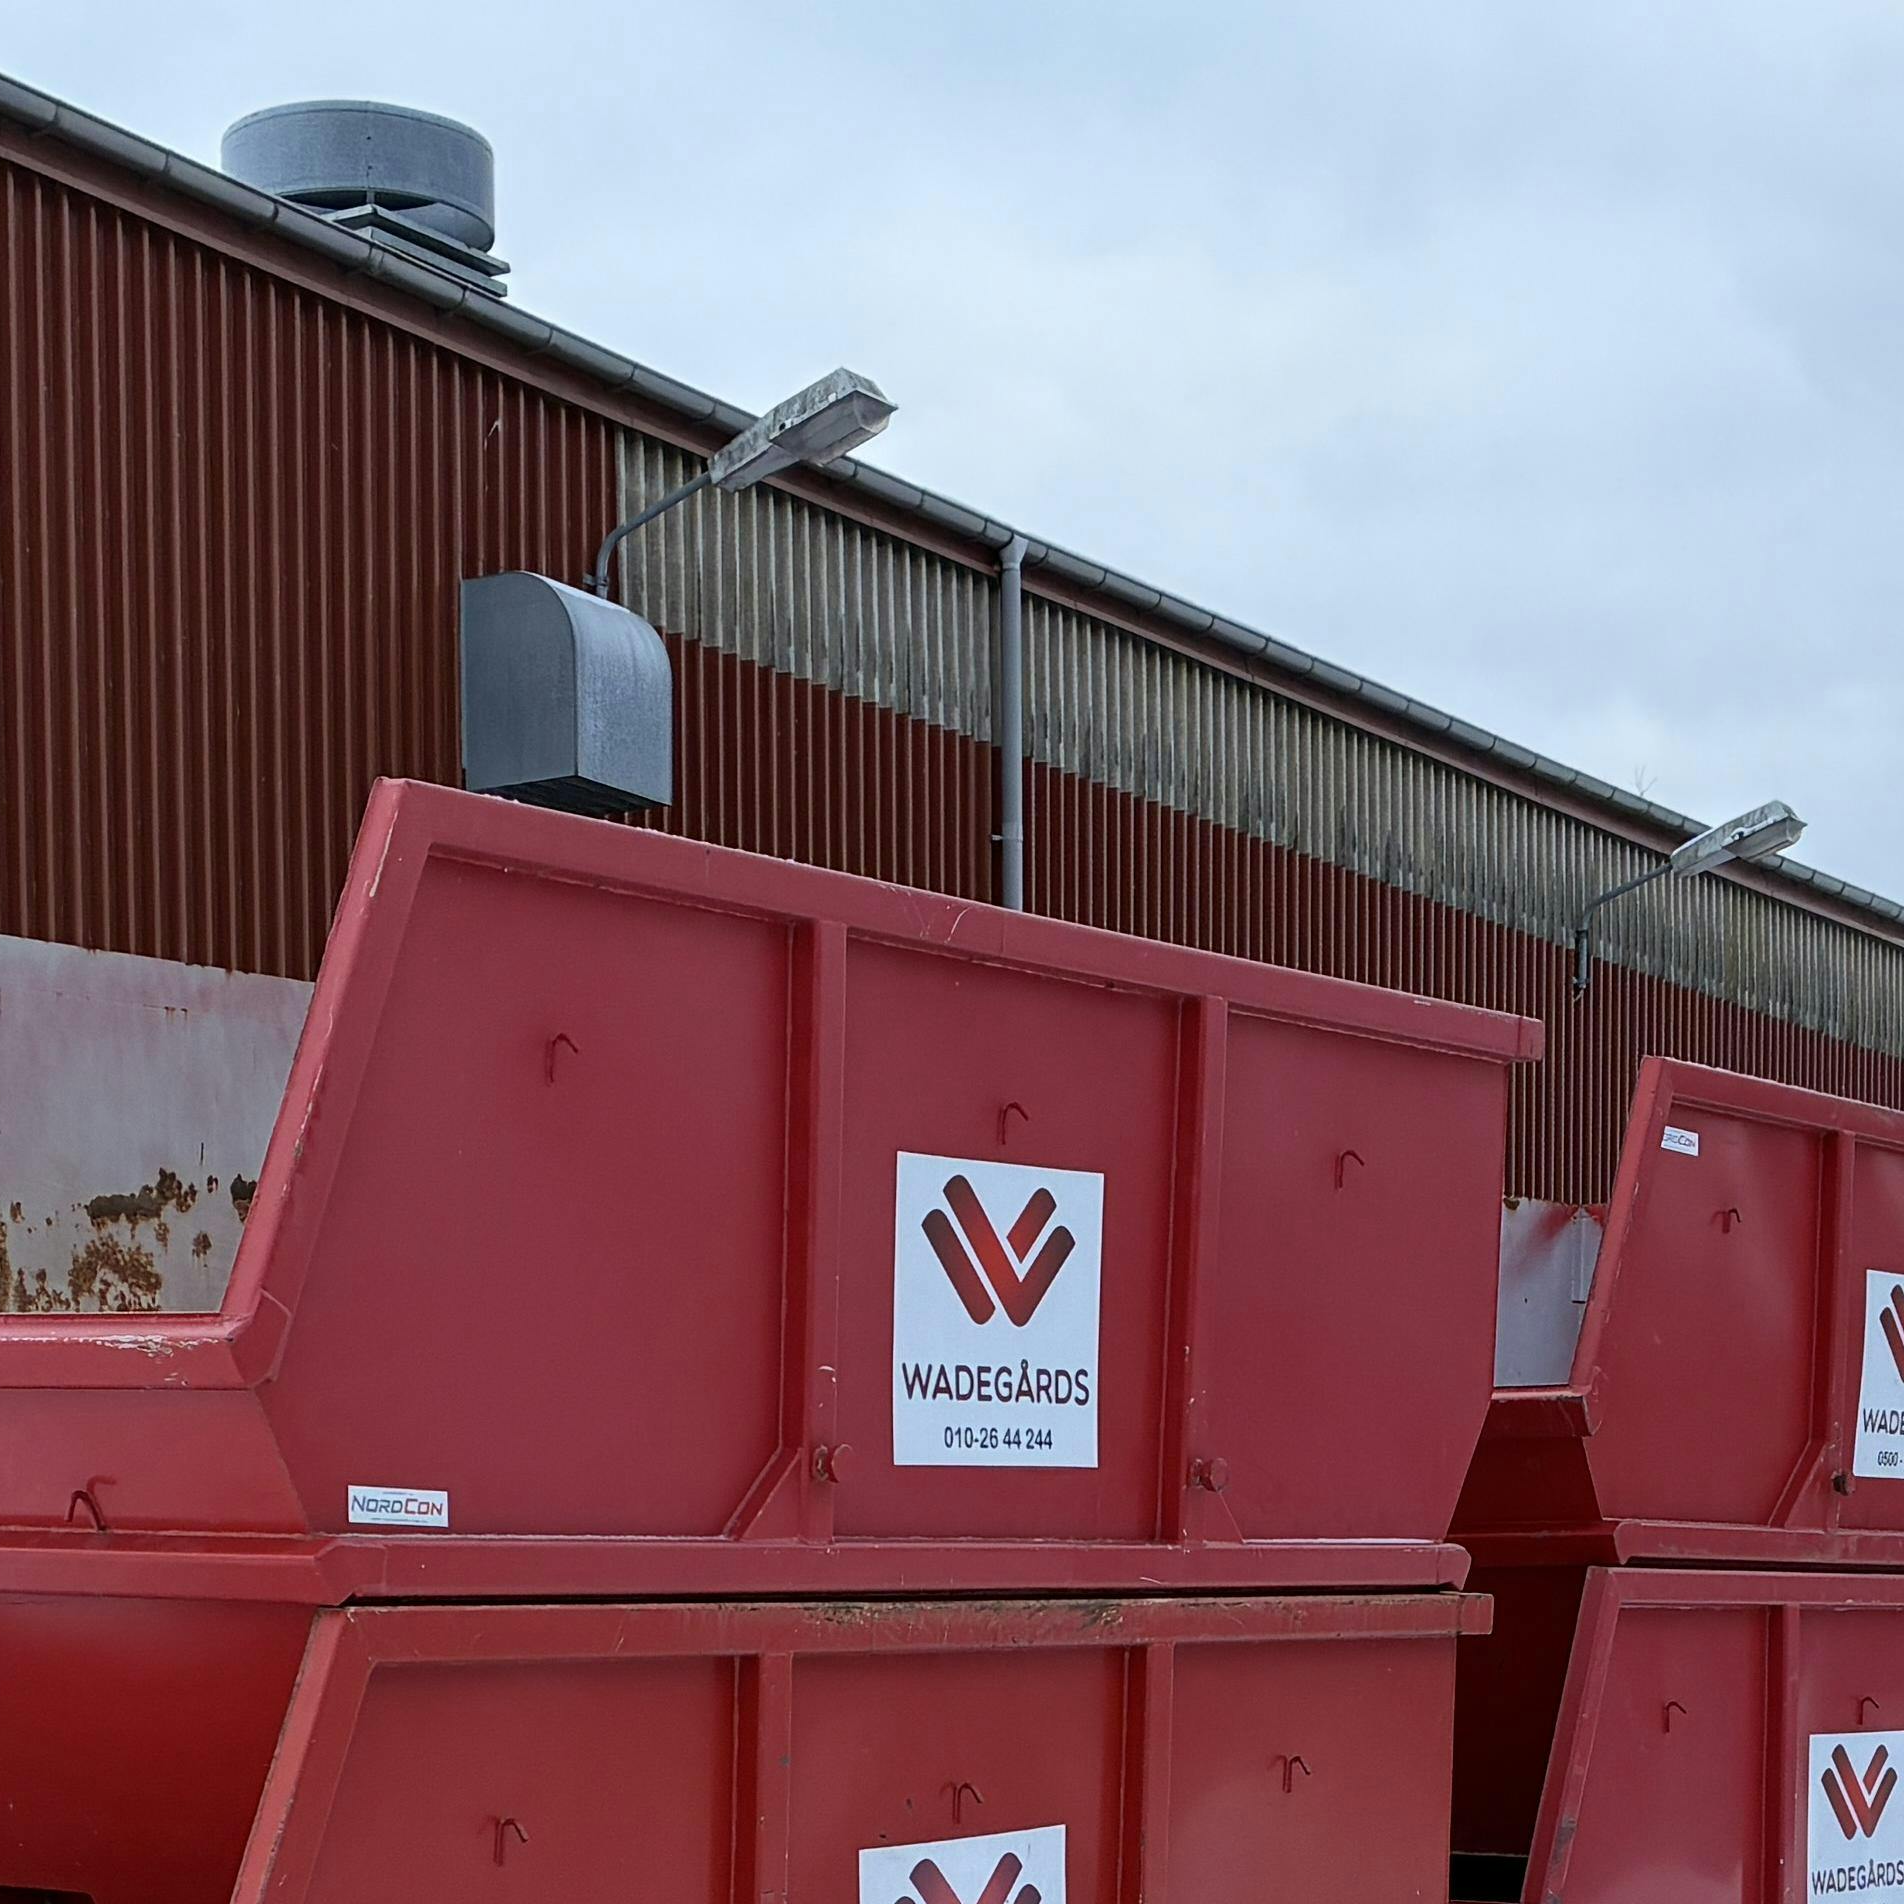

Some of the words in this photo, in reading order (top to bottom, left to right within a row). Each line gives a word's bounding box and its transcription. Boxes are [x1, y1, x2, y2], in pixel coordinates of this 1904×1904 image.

[902, 1358, 1090, 1406] WADEGÅRDS
[944, 1426, 998, 1449] 010-26
[1002, 1427, 1022, 1449] 44
[1025, 1428, 1053, 1450] 244
[1812, 1858, 1904, 1896] WADEGÅRDS
